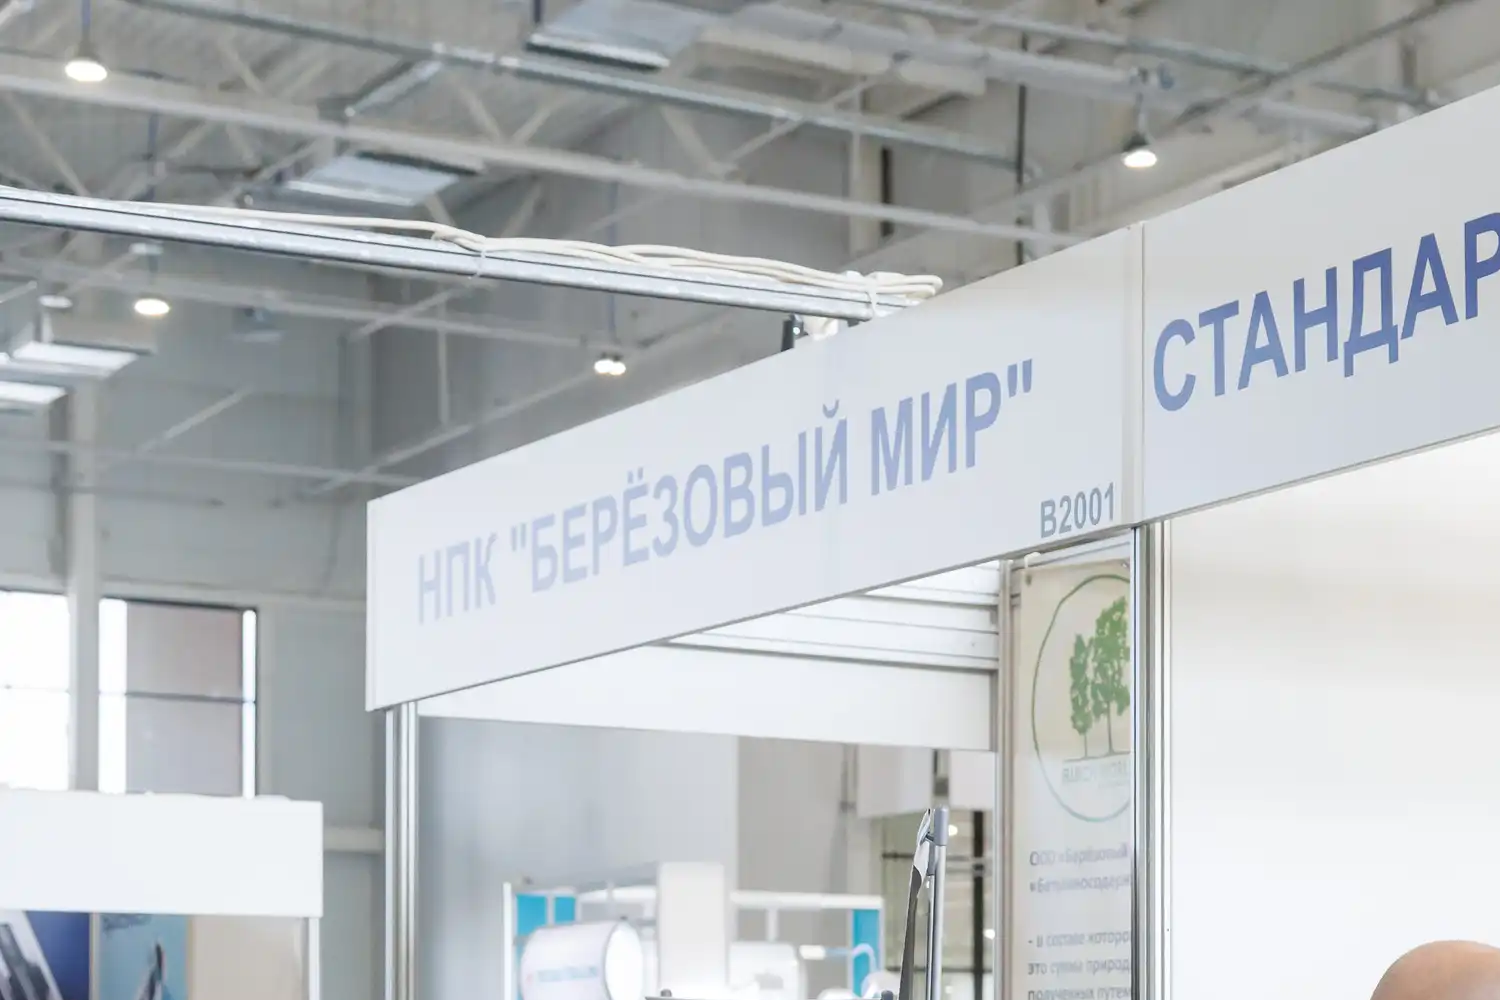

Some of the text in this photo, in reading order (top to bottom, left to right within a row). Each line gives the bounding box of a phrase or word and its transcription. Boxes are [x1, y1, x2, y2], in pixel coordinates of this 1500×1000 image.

[417, 358, 1034, 625] НПК "БЕРЁЗОВЫЙ МИР"
